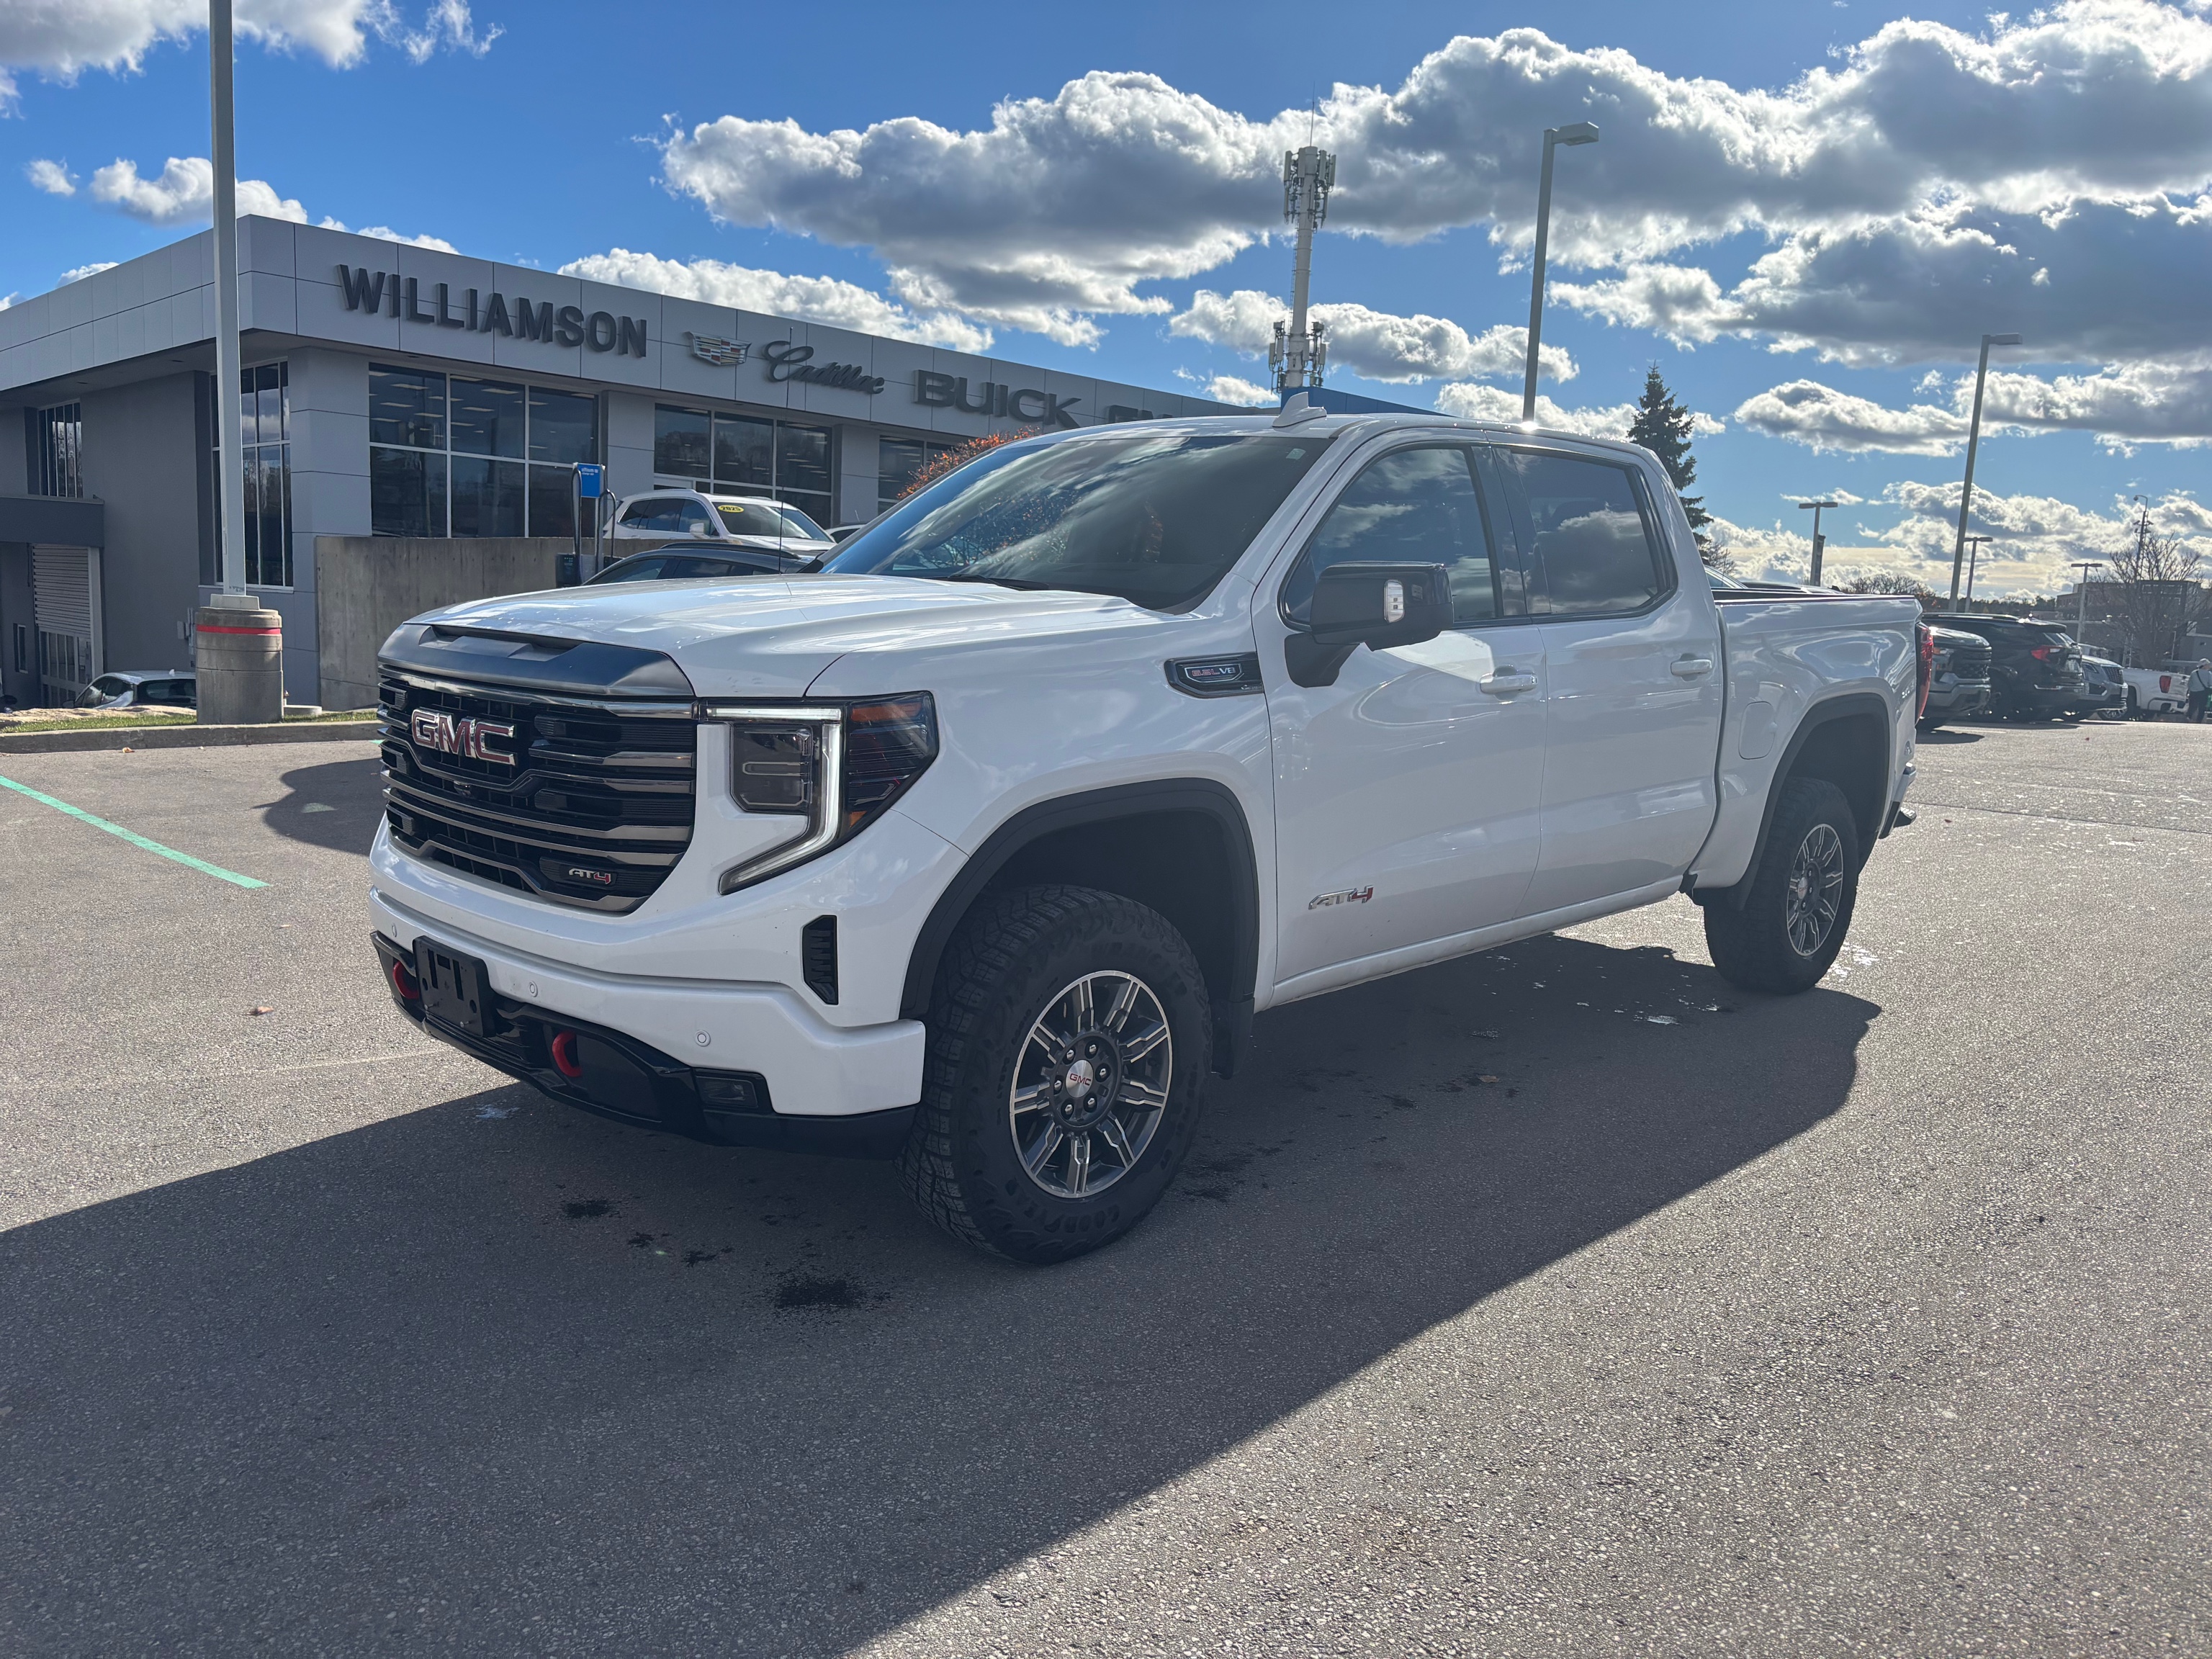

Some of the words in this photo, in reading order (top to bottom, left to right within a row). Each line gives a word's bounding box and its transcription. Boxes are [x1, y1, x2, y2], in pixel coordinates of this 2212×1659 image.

[336, 264, 647, 358] WILLIAMSON
[762, 341, 885, 395] Cadillac
[914, 369, 1082, 428] BUICK
[411, 707, 516, 766] GMC
[569, 868, 611, 884] AT4
[1308, 885, 1375, 909] AT4
[1069, 1073, 1092, 1087] GMC
